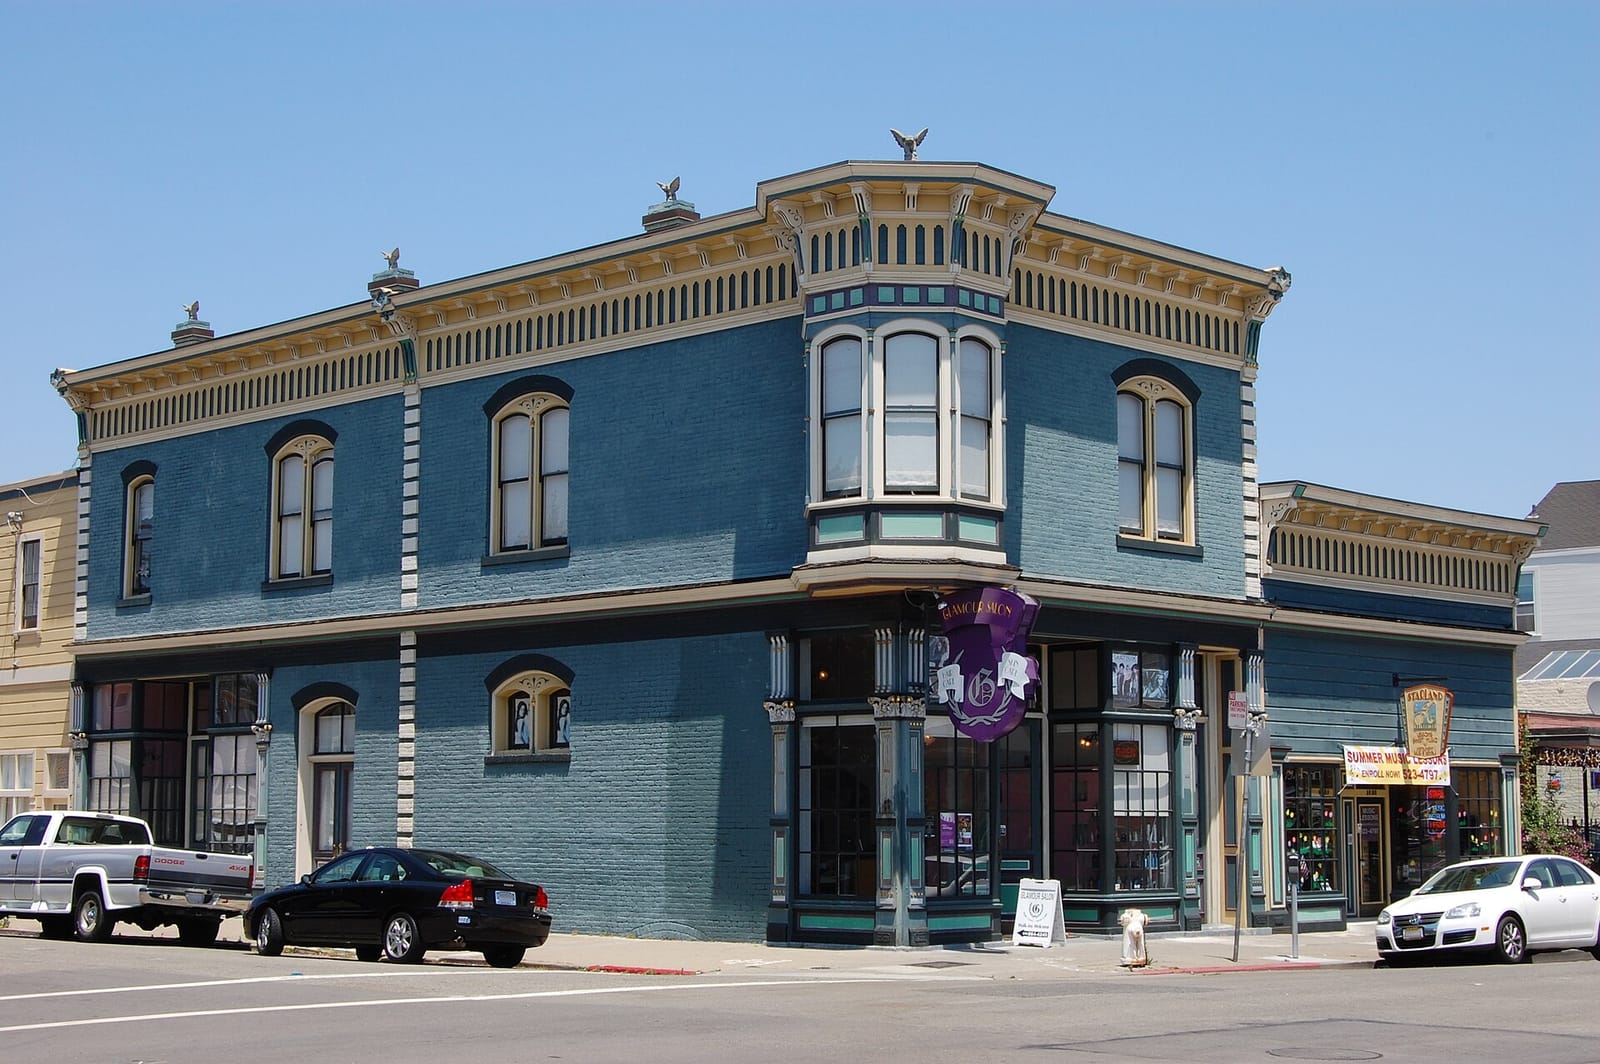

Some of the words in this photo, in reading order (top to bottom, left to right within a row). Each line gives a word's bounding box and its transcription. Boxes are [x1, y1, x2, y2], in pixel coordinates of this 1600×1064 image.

[942, 601, 985, 620] GLAMOUR
[987, 602, 1012, 617] SALON
[1407, 689, 1443, 701] STARLAND
[1347, 751, 1384, 764] SUMMER
[1385, 753, 1411, 765] MUSIC
[1413, 755, 1447, 766] LESSONS
[1361, 770, 1384, 778] ENROLL
[1402, 769, 1438, 780] 523-4797
[154, 858, 185, 866] DODGE
